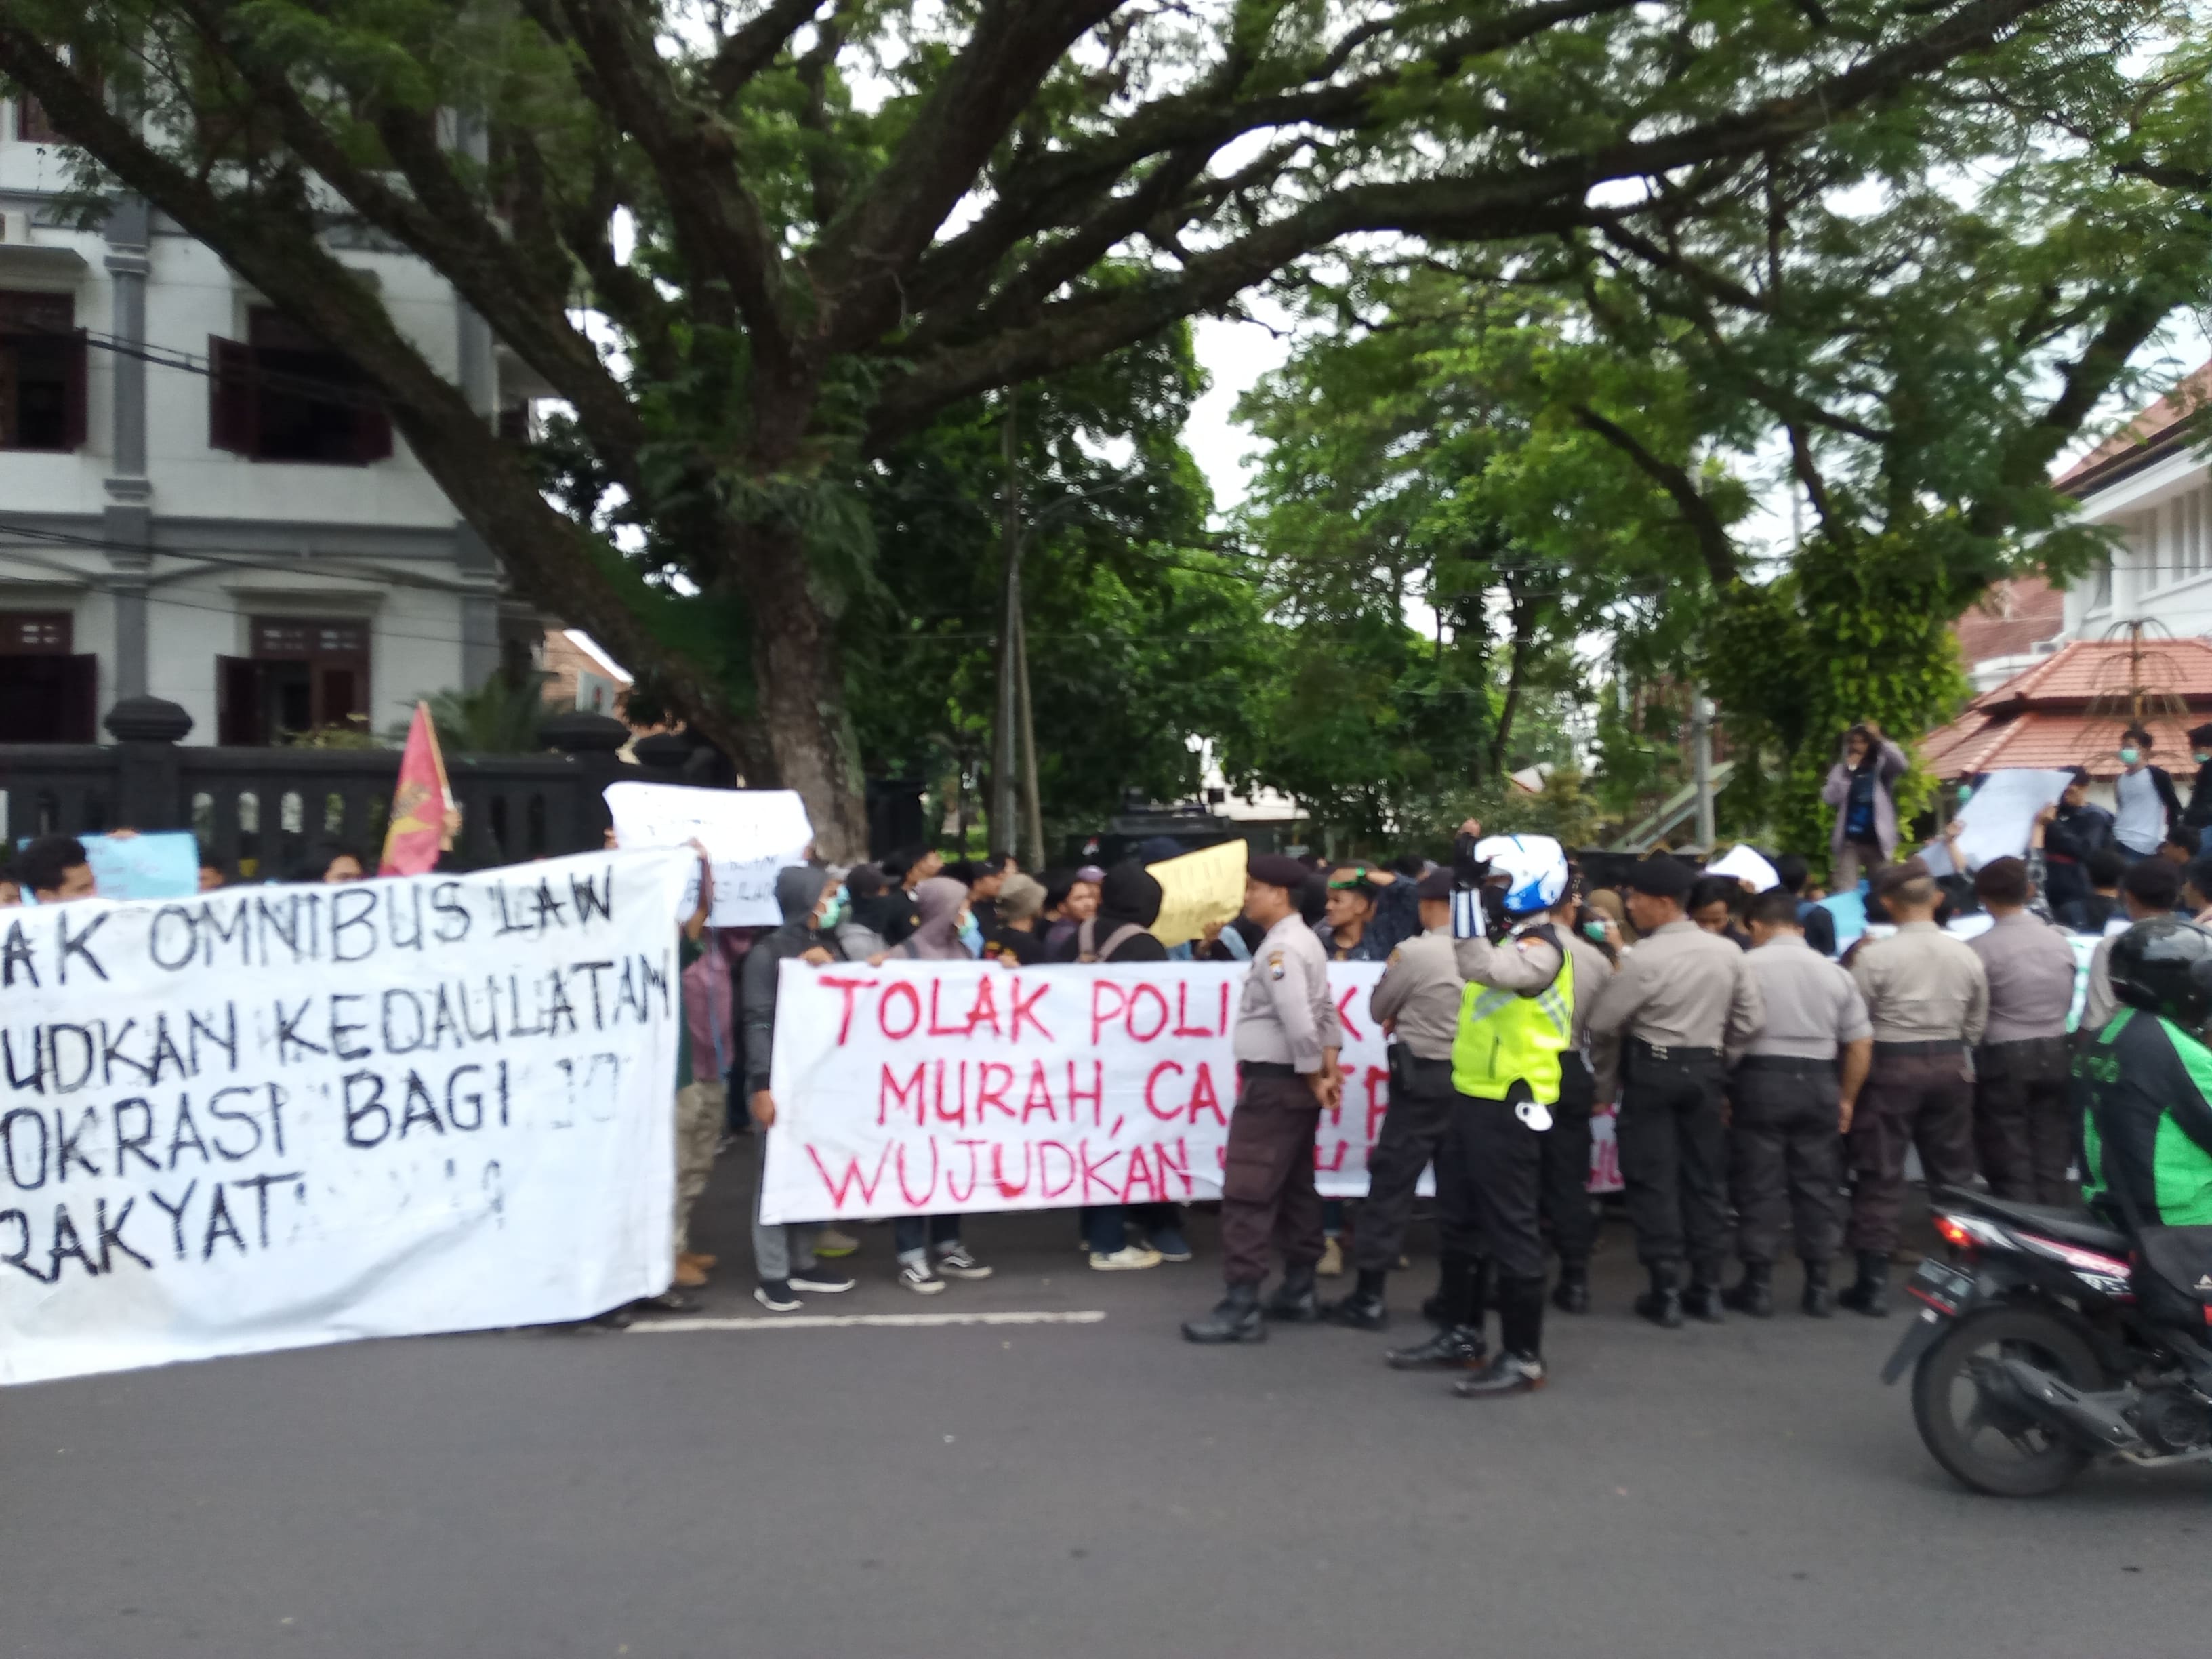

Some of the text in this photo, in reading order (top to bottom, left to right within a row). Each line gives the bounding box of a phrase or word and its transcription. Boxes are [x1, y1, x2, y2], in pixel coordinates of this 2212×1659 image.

[149, 881, 471, 971] OMNIBUS
[491, 863, 613, 938] LAW
[1, 947, 670, 1096] UDKAN KEDAULATAN
[815, 975, 1056, 1047] TOLAK
[1, 1081, 288, 1191] OKRASI
[342, 1059, 510, 1149] BAGI
[877, 1057, 1124, 1139] MURAH,
[805, 1136, 1195, 1210] WUJUDKAN
